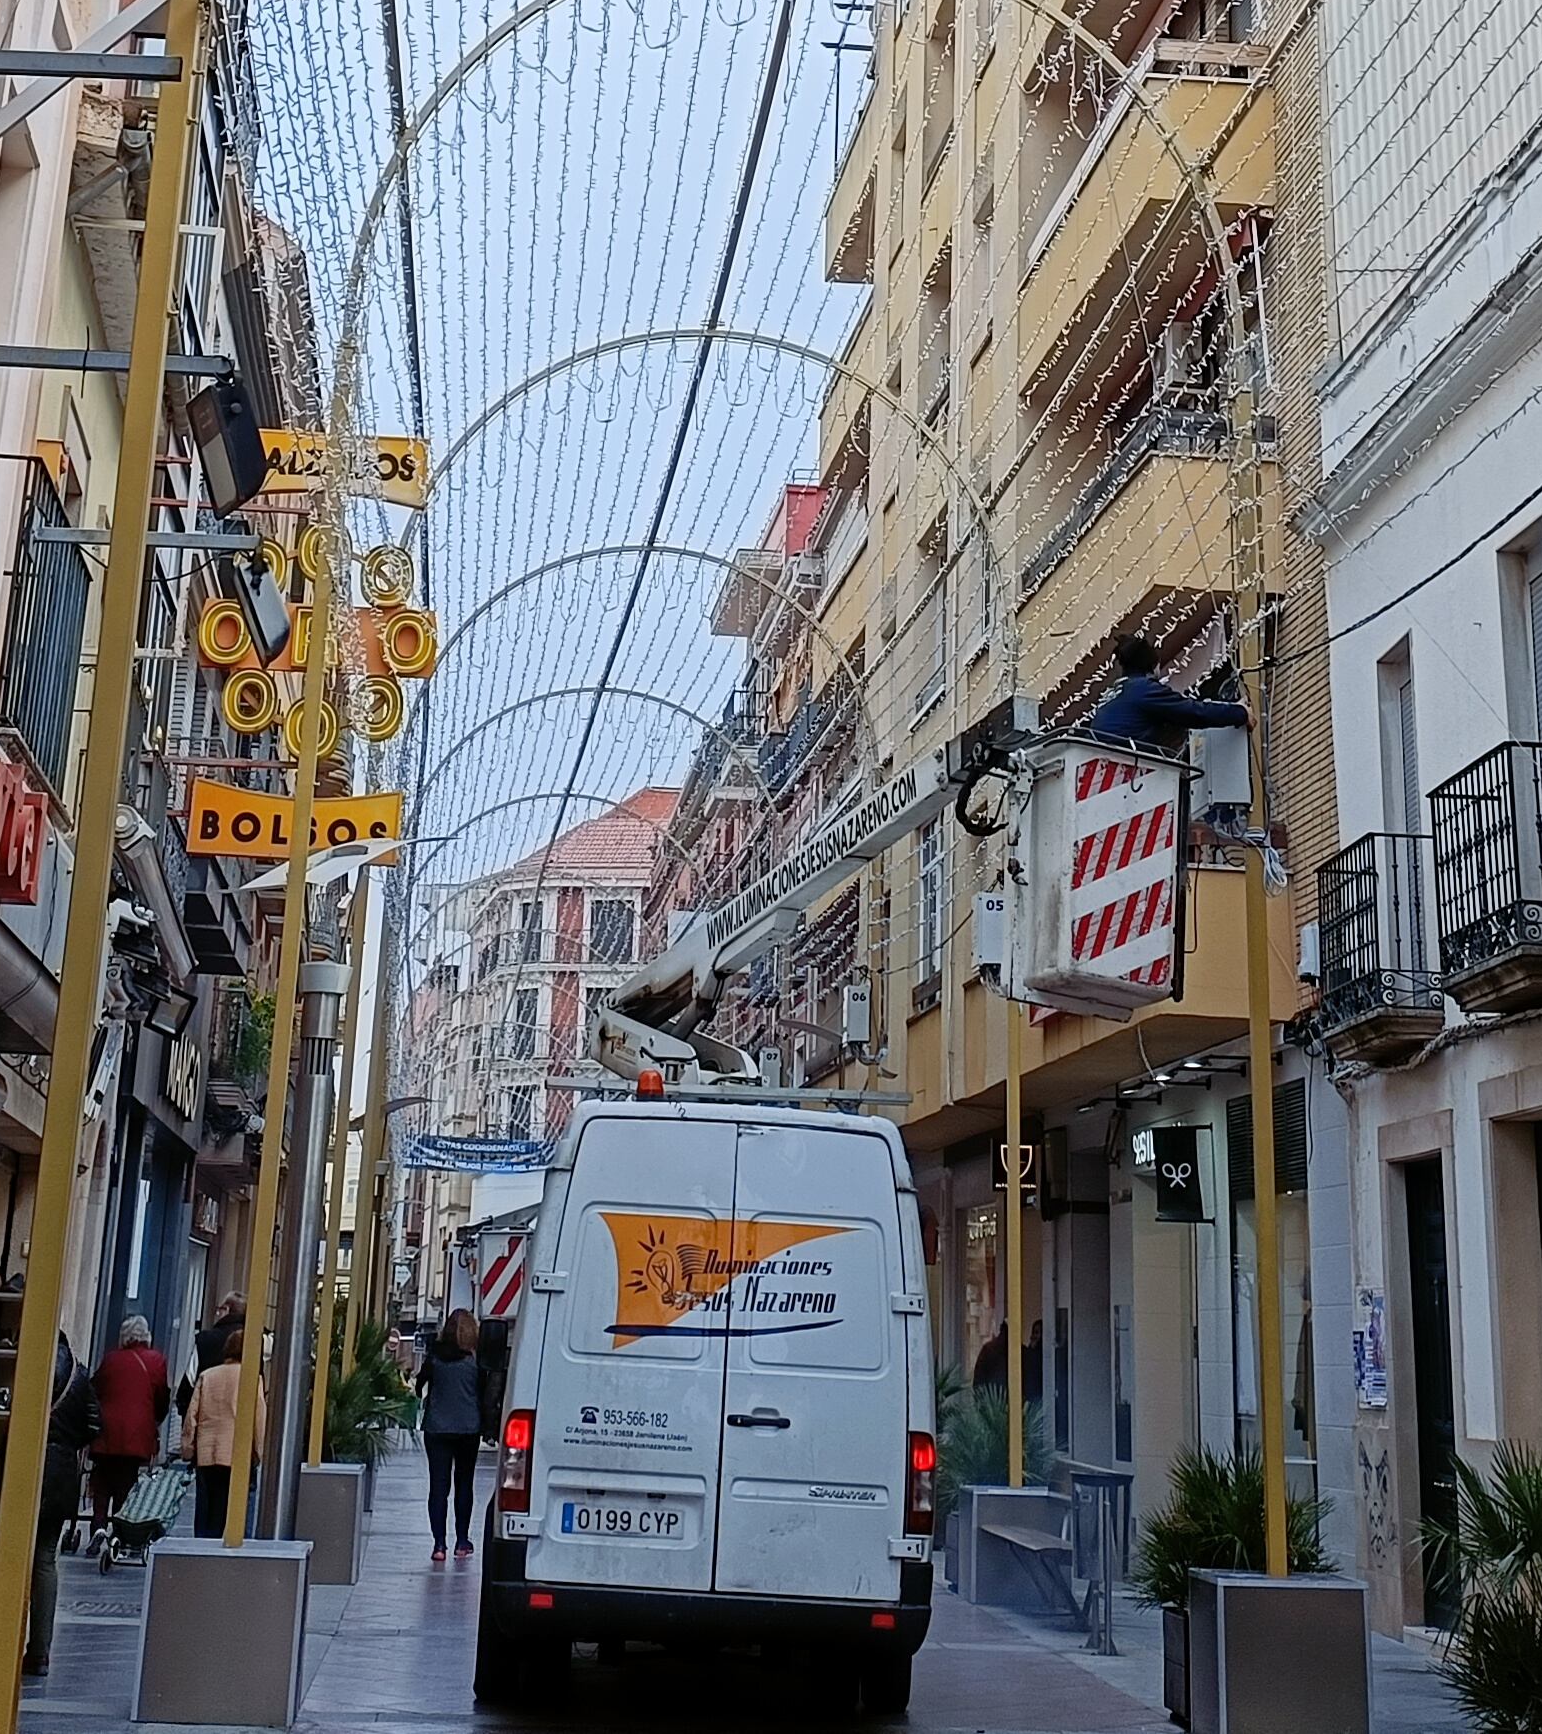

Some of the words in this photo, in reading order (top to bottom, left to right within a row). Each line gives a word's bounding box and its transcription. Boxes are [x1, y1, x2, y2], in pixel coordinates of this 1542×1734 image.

[267, 447, 416, 482] ALZOS
[706, 768, 917, 950] WWW.ILUMINACIONESJESUSNAZARENO.COM
[985, 899, 1004, 912] 05
[852, 992, 867, 1002] 06
[766, 1052, 778, 1061] 07
[166, 1032, 201, 1122] MANGO
[703, 1248, 833, 1276] Iluminaciones
[739, 1275, 837, 1314] Nazareno
[603, 1409, 668, 1428] 953-566-182
[578, 1508, 632, 1532] 0199
[639, 1511, 679, 1535] CYP
